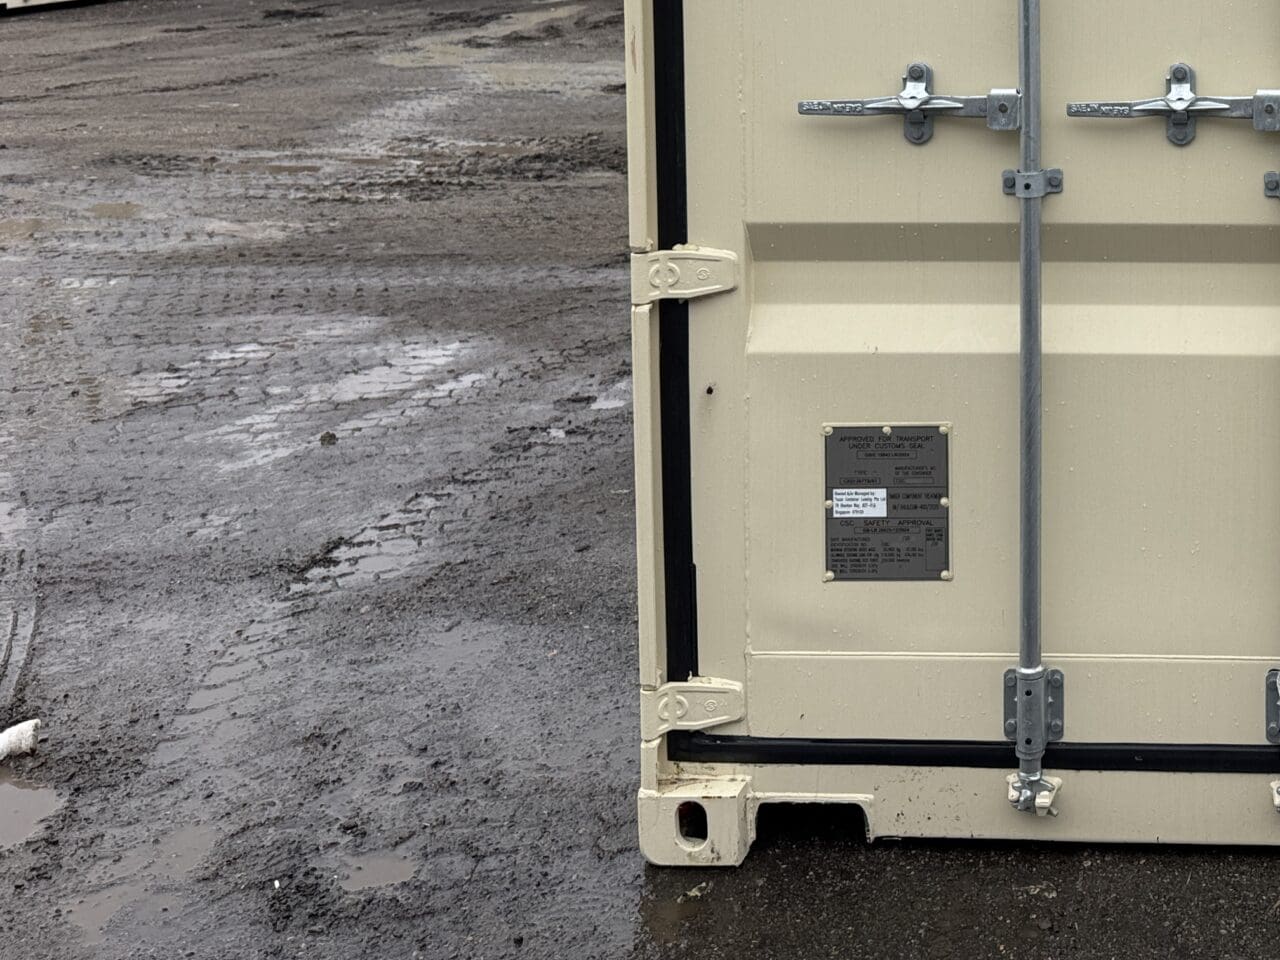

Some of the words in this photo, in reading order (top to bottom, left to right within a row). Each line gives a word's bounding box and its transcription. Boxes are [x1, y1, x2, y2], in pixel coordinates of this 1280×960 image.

[839, 435, 875, 443] APPROVED
[879, 435, 892, 443] FOR
[896, 434, 935, 442] TRANSPORT
[848, 442, 871, 450] UNDER
